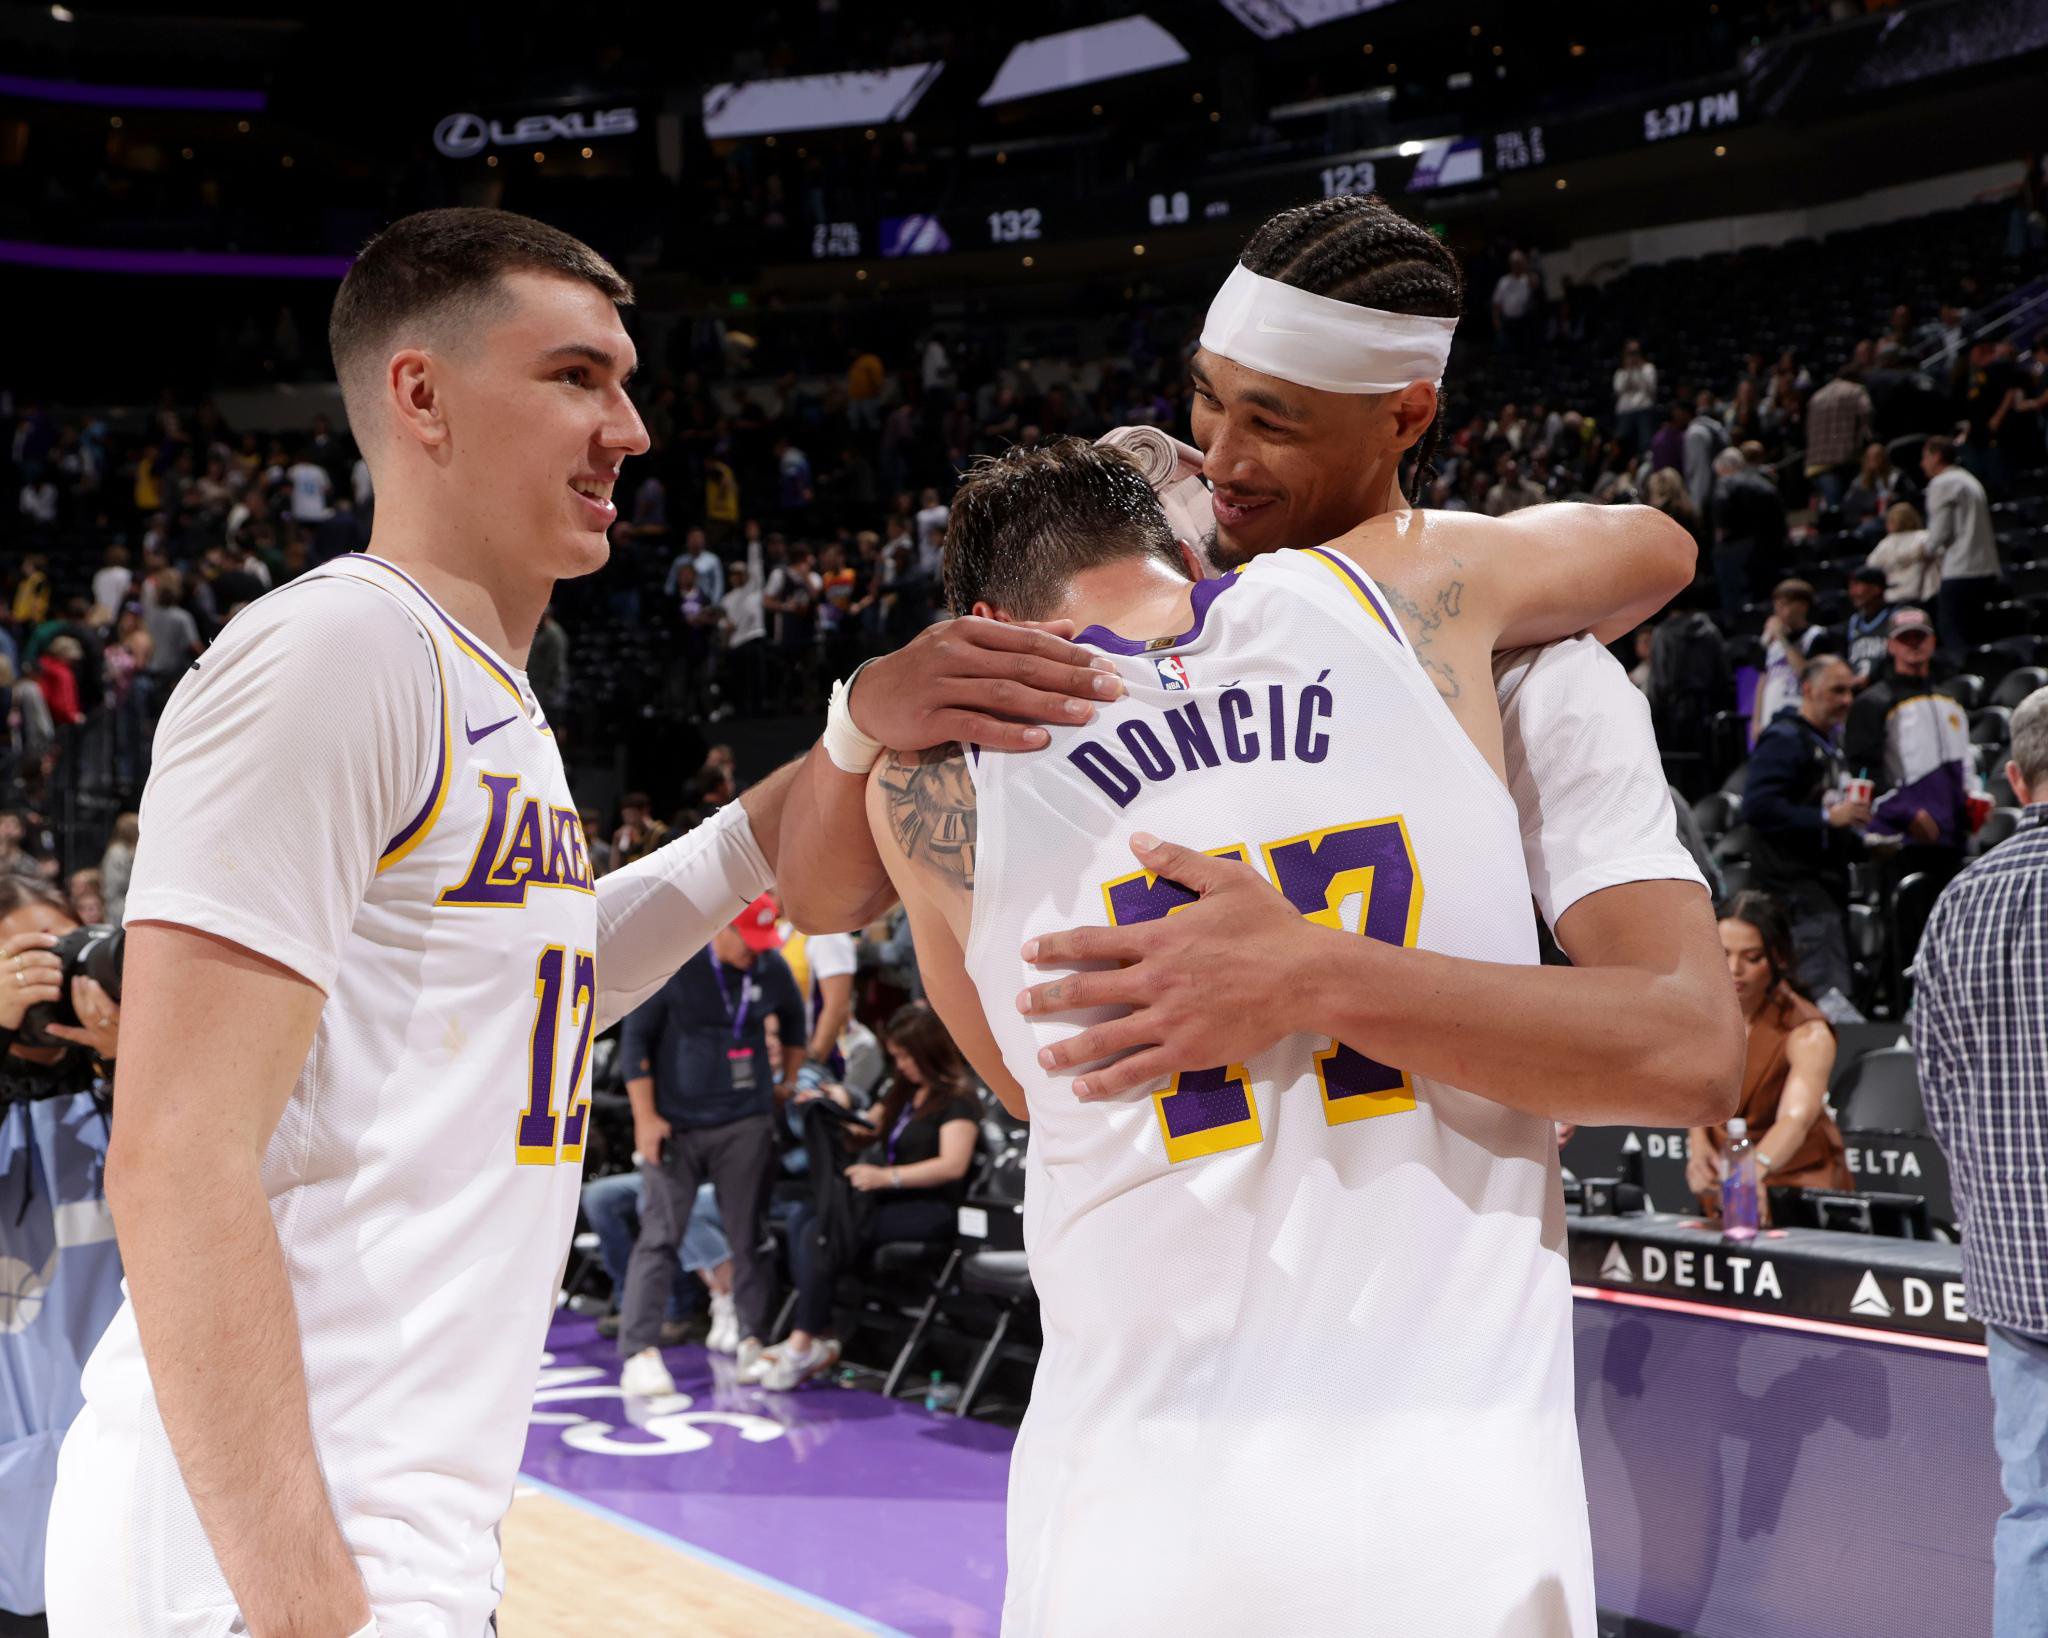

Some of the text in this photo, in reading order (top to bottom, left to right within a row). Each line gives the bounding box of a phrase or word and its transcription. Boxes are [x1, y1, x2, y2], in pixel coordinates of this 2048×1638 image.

[490, 107, 638, 145] LEXUS
[1644, 89, 1740, 142] 5:37 PM
[1320, 161, 1376, 200] 123
[988, 207, 1042, 243] 132
[1165, 680, 1182, 691] NBA
[1067, 668, 1334, 808] DONČIĆ
[434, 768, 597, 909] LAKE
[515, 943, 597, 1166] 12
[1845, 1147, 1922, 1178] ELTA
[1642, 1245, 1783, 1299] DELTA
[1902, 1277, 1969, 1323] DE
